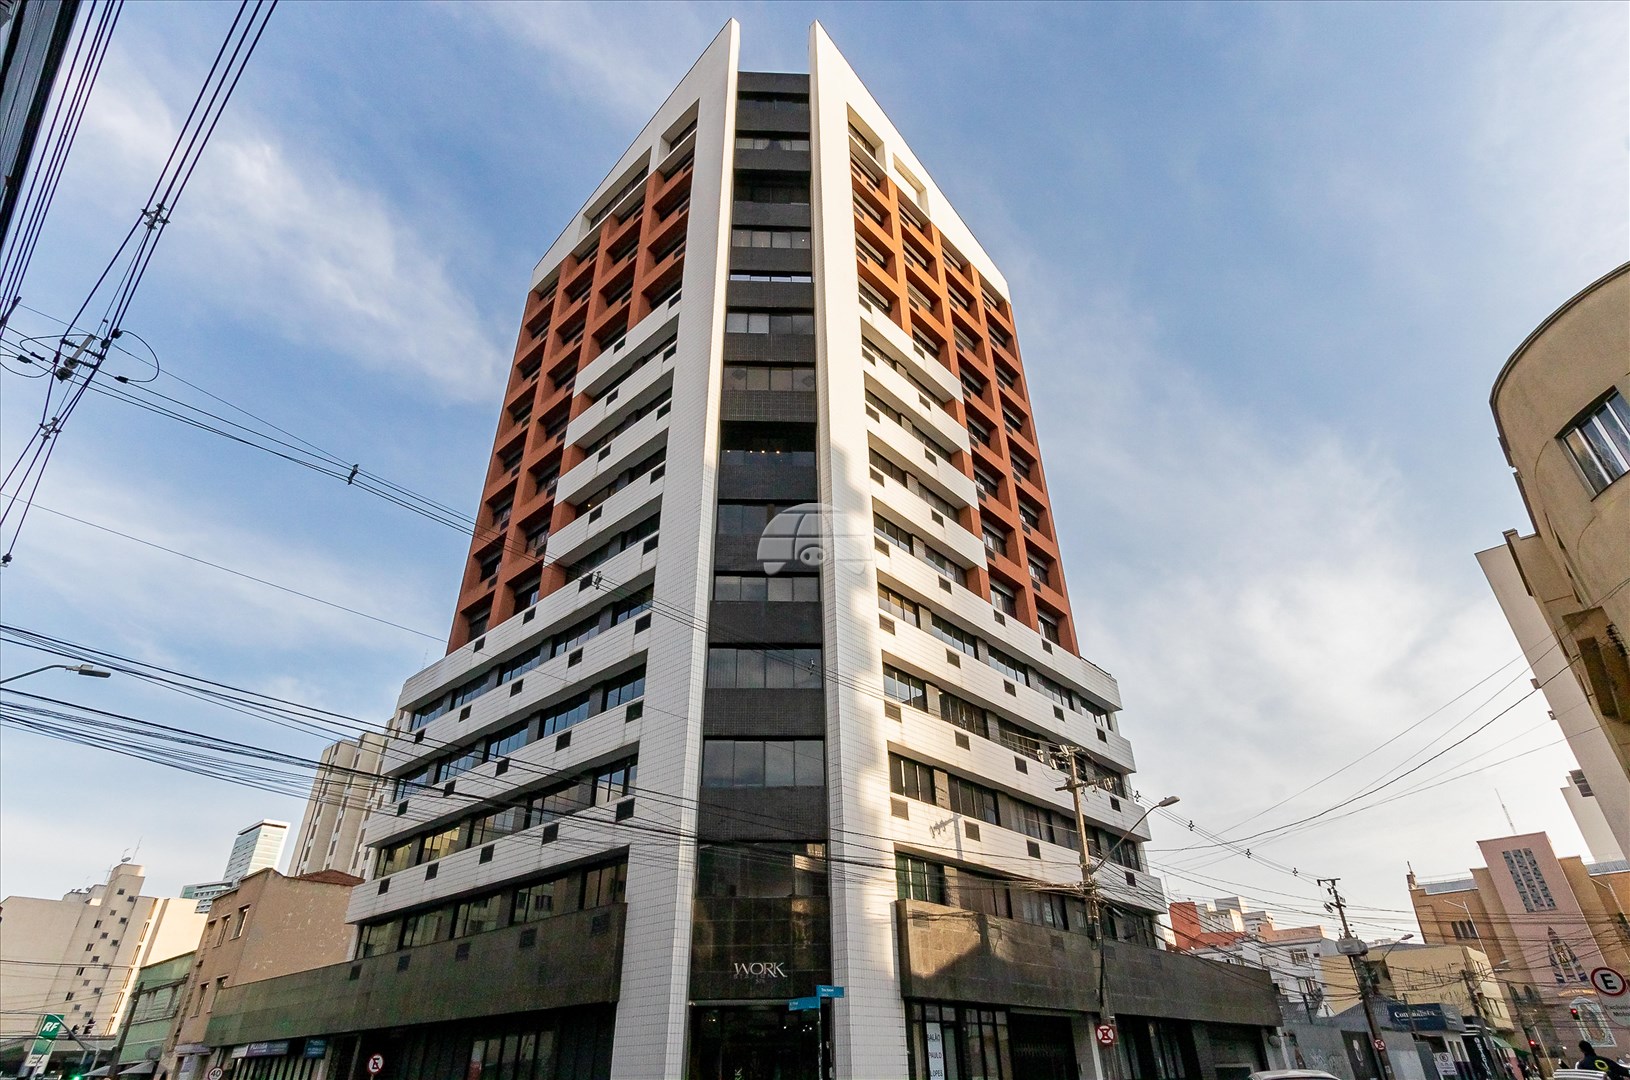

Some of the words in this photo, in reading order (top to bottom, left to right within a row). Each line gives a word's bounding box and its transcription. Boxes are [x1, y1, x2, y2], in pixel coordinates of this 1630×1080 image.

[734, 962, 788, 978] WORK
[1600, 973, 1618, 990] E
[42, 1021, 60, 1032] RF
[210, 1069, 221, 1078] 40
